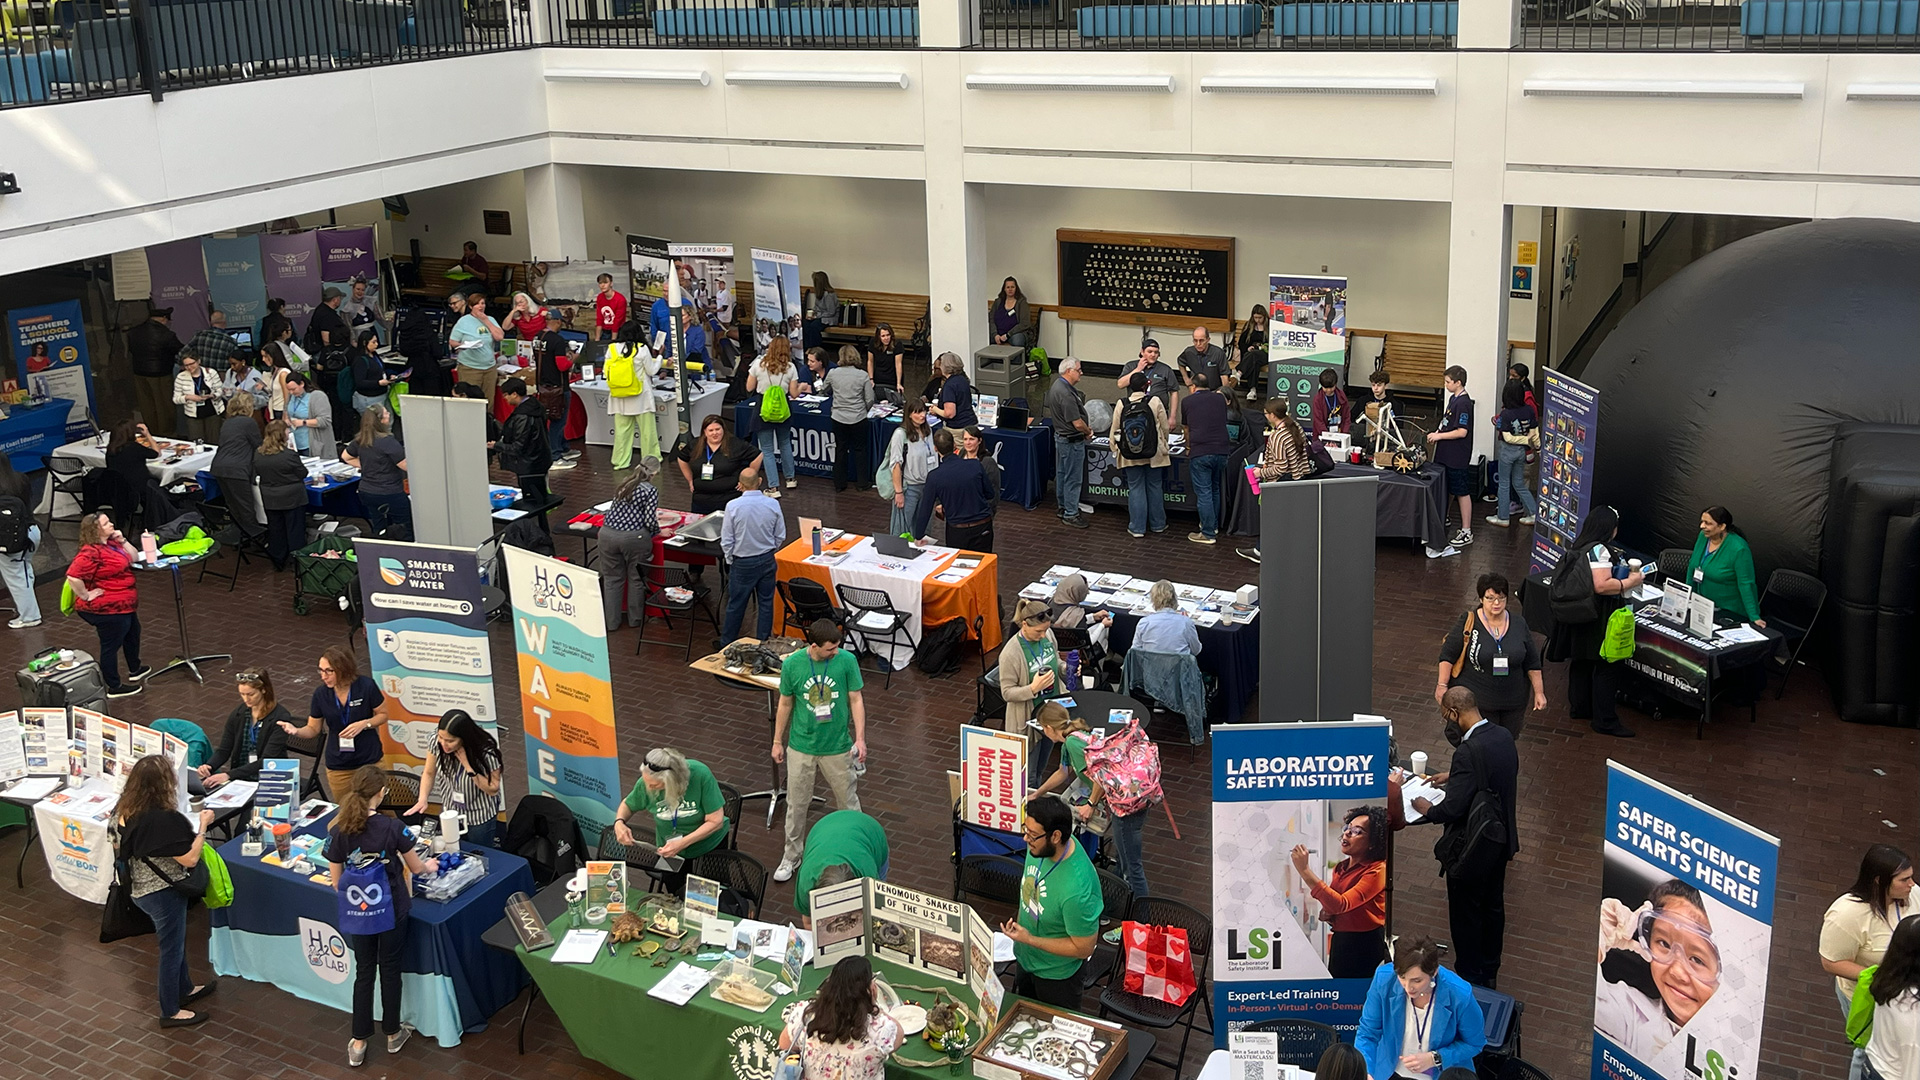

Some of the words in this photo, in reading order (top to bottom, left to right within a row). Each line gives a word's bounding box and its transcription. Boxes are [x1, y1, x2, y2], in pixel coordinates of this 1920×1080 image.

[18, 319, 70, 333] TEACHERS
[20, 331, 28, 340] &
[28, 326, 69, 339] SCHOOL
[21, 331, 78, 346] EMPLOYEES
[1288, 331, 1317, 342] BEST
[818, 463, 834, 472] CENTE
[1088, 485, 1118, 497] NORTH
[1164, 493, 1187, 503] BEST
[407, 559, 455, 573] SMARTER
[408, 570, 442, 580] ABOUT
[409, 579, 445, 590] WATER
[550, 597, 577, 618] LAB!
[1662, 672, 1675, 685] THE
[977, 746, 996, 798] Nature
[1226, 754, 1374, 775] LABORATORY
[999, 748, 1017, 809] Armand
[1226, 774, 1287, 789] SAFETY
[1290, 773, 1374, 788] INSTITUTE
[999, 811, 1017, 832] Ba
[1618, 801, 1677, 843] SAFER
[1679, 831, 1761, 885] SCIENCE
[1617, 821, 1692, 873] STARTS
[1695, 860, 1759, 909] HERE!
[875, 882, 921, 903] VENOMOUS
[925, 897, 959, 914] SNAKES
[886, 899, 897, 908] OF
[902, 903, 918, 915] THE
[923, 909, 946, 923] U.S.A.
[324, 956, 349, 974] LAB!
[1227, 989, 1290, 1003] Expert-Led
[1292, 989, 1340, 1001] Training
[1227, 1004, 1271, 1013] In-Person
[1277, 1004, 1308, 1012] Virtual
[1314, 1002, 1364, 1011] On-Deman
[727, 1024, 763, 1047] Armand
[1603, 1049, 1647, 1080] Empow
